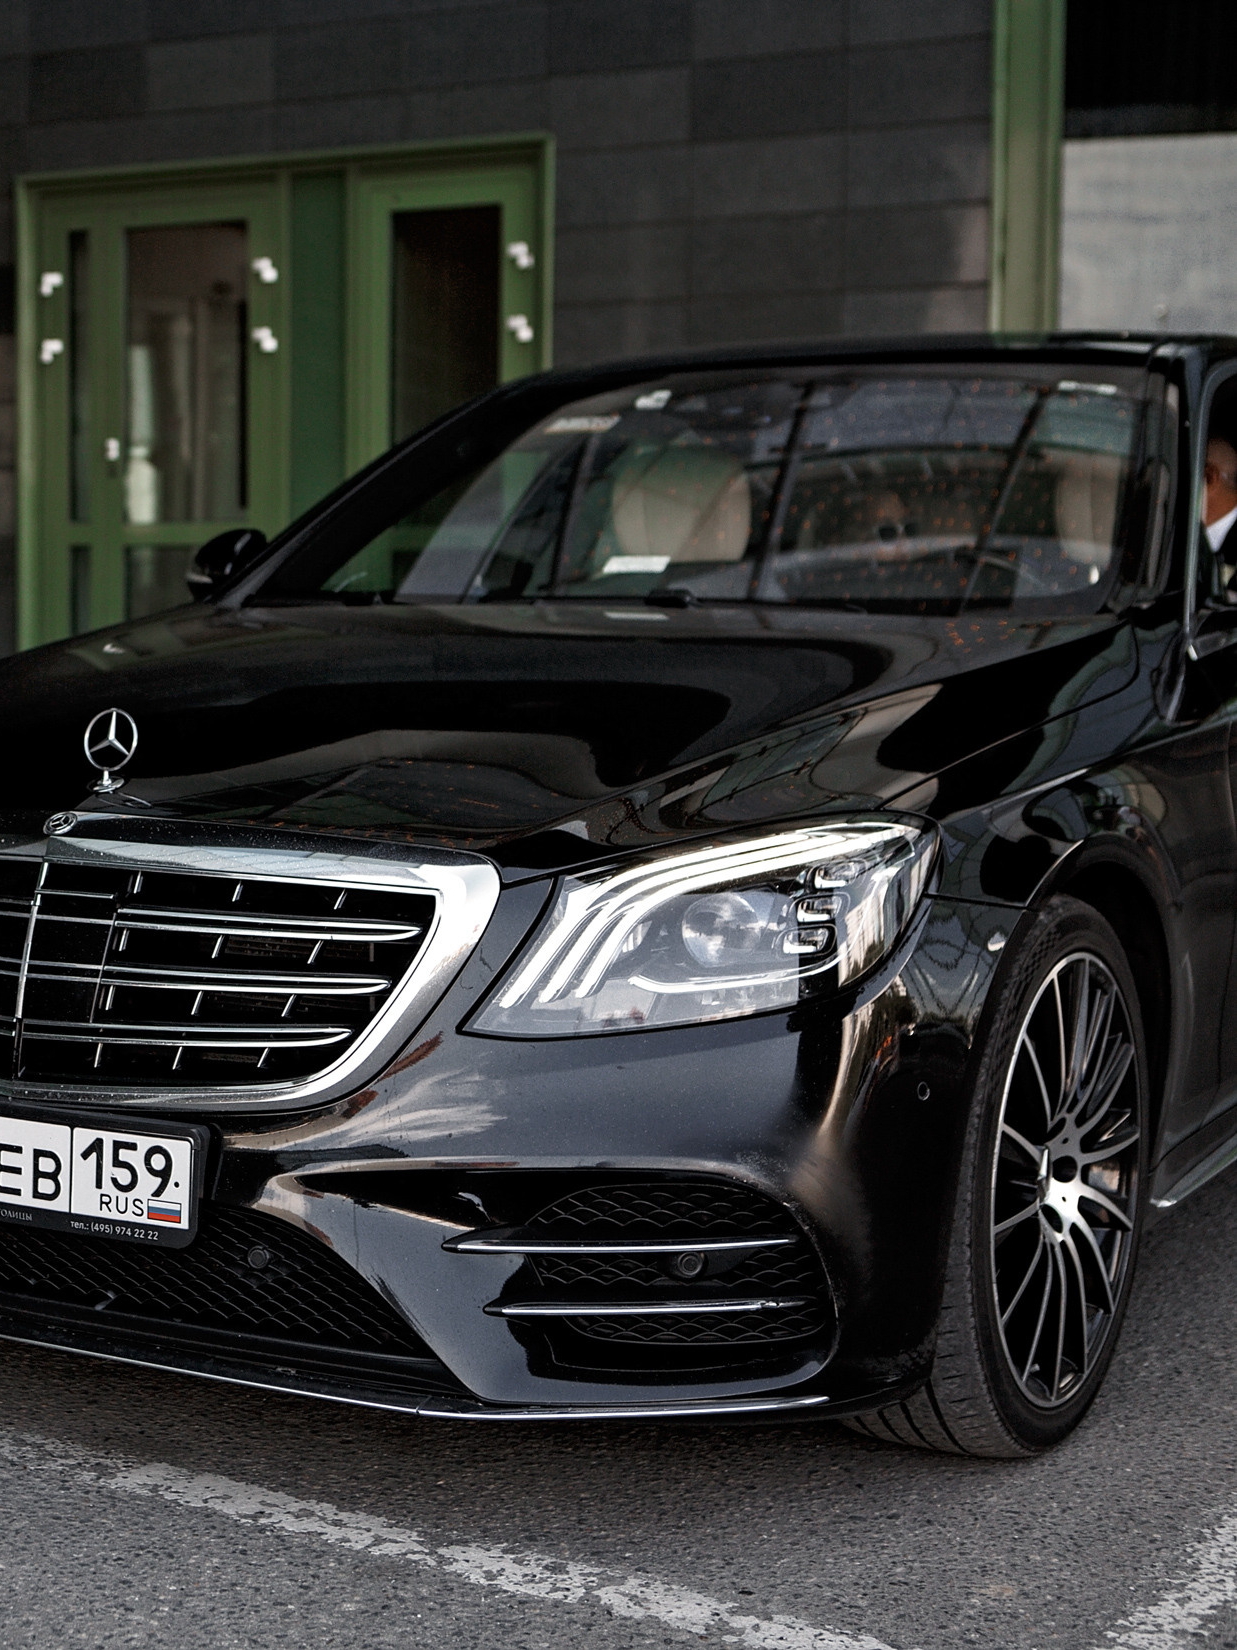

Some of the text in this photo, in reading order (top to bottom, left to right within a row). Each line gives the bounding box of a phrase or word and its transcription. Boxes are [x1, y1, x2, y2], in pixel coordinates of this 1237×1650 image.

[80, 1137, 174, 1198] 159
[100, 1193, 144, 1217] RUS
[70, 1220, 159, 1241] тел.: (495) 974 22 22
